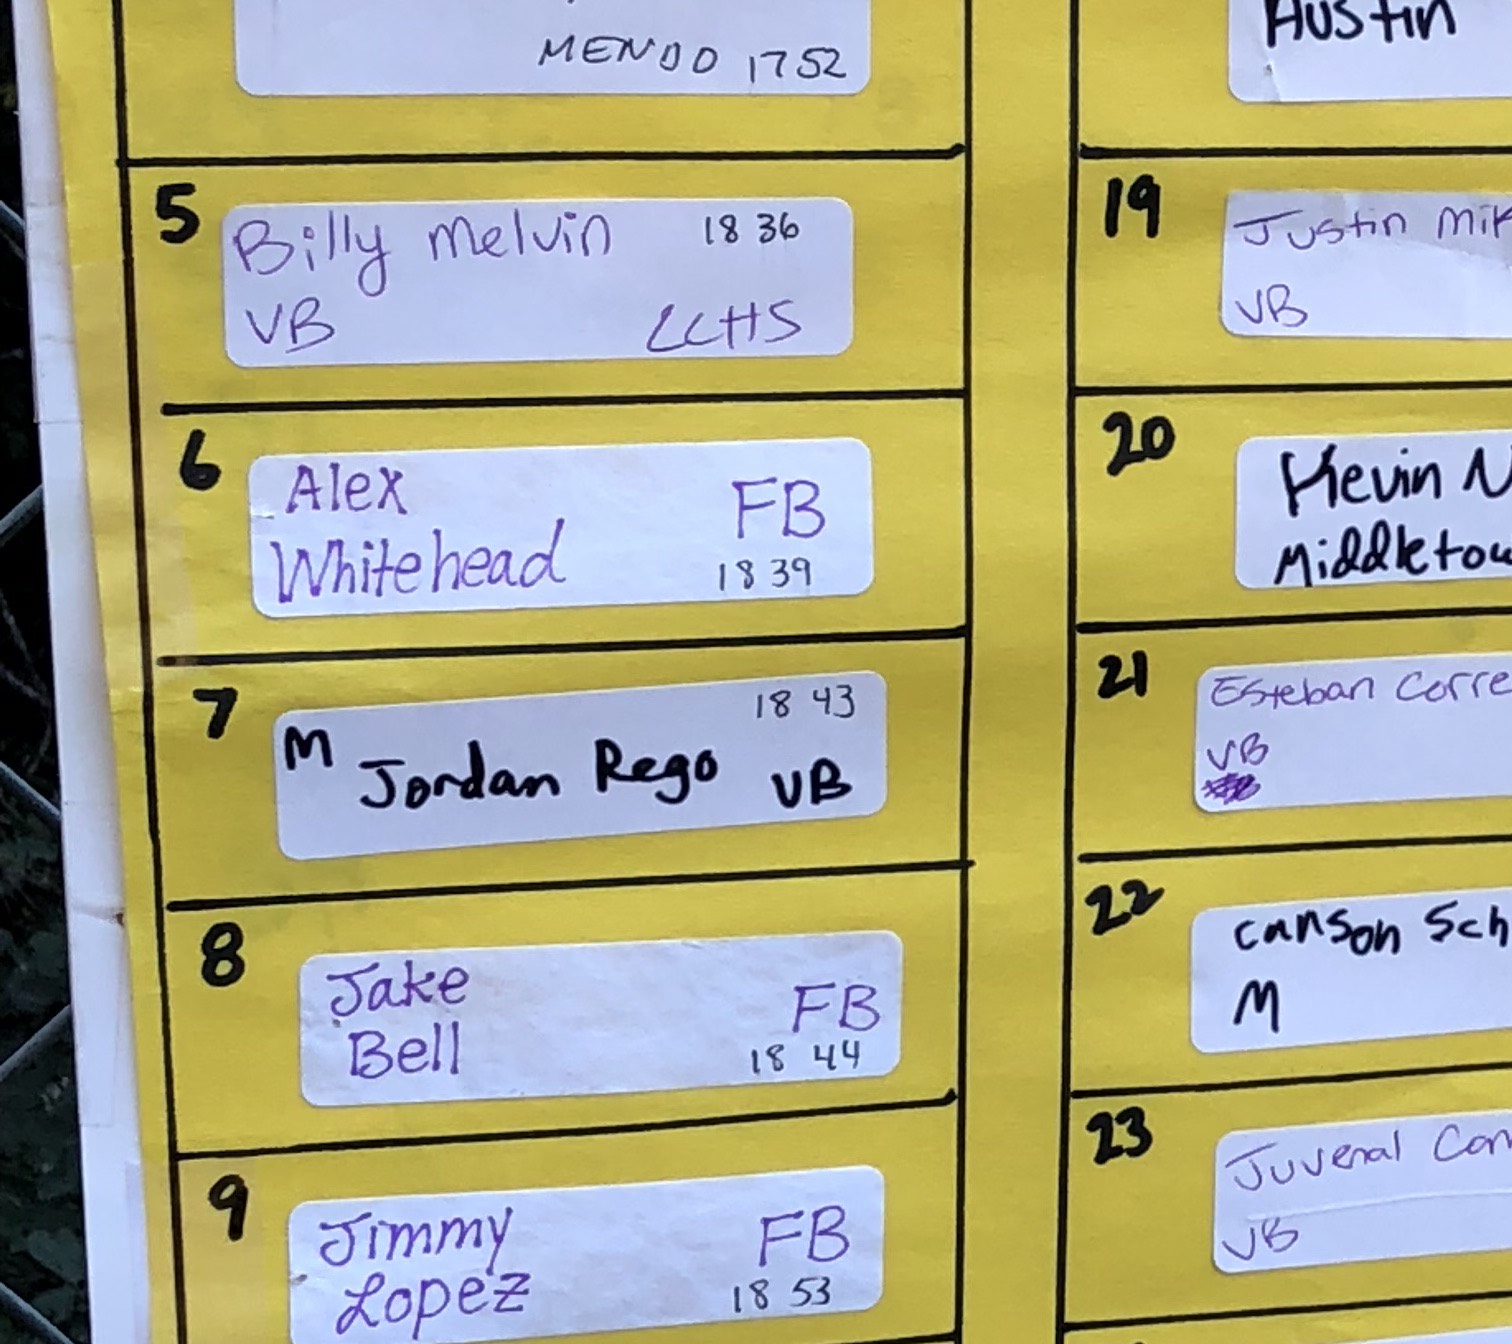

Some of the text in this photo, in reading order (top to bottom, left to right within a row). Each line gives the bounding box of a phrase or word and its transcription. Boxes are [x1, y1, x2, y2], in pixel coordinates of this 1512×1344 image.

[155, 182, 201, 245] 5
[1104, 173, 1161, 239] 19
[1233, 209, 1407, 250] Justin
[232, 208, 391, 297] Billy
[245, 297, 335, 354] VB
[1234, 284, 1308, 328] VB
[178, 428, 222, 492] 6
[1102, 410, 1176, 478] 20
[285, 462, 408, 515] Alex
[731, 476, 826, 539] FB
[1280, 440, 1442, 519] Kevin
[1097, 650, 1149, 699] 21
[192, 686, 239, 740] 7
[283, 725, 334, 771] M
[358, 738, 719, 810] Jordan Rego
[1207, 732, 1269, 771] VB
[770, 757, 853, 809] VB
[1084, 878, 1165, 936] 22
[200, 921, 246, 987] 8
[325, 959, 470, 1018] Jake
[790, 981, 881, 1036] FB
[1232, 978, 1280, 1034] M
[348, 1020, 459, 1079] Bell
[1085, 1106, 1153, 1166] 23
[207, 1174, 249, 1242] 9
[758, 1205, 850, 1268] FB
[1222, 1214, 1301, 1261] VB
[318, 1206, 520, 1280] Jimmy
[335, 1264, 531, 1344] Lopez
